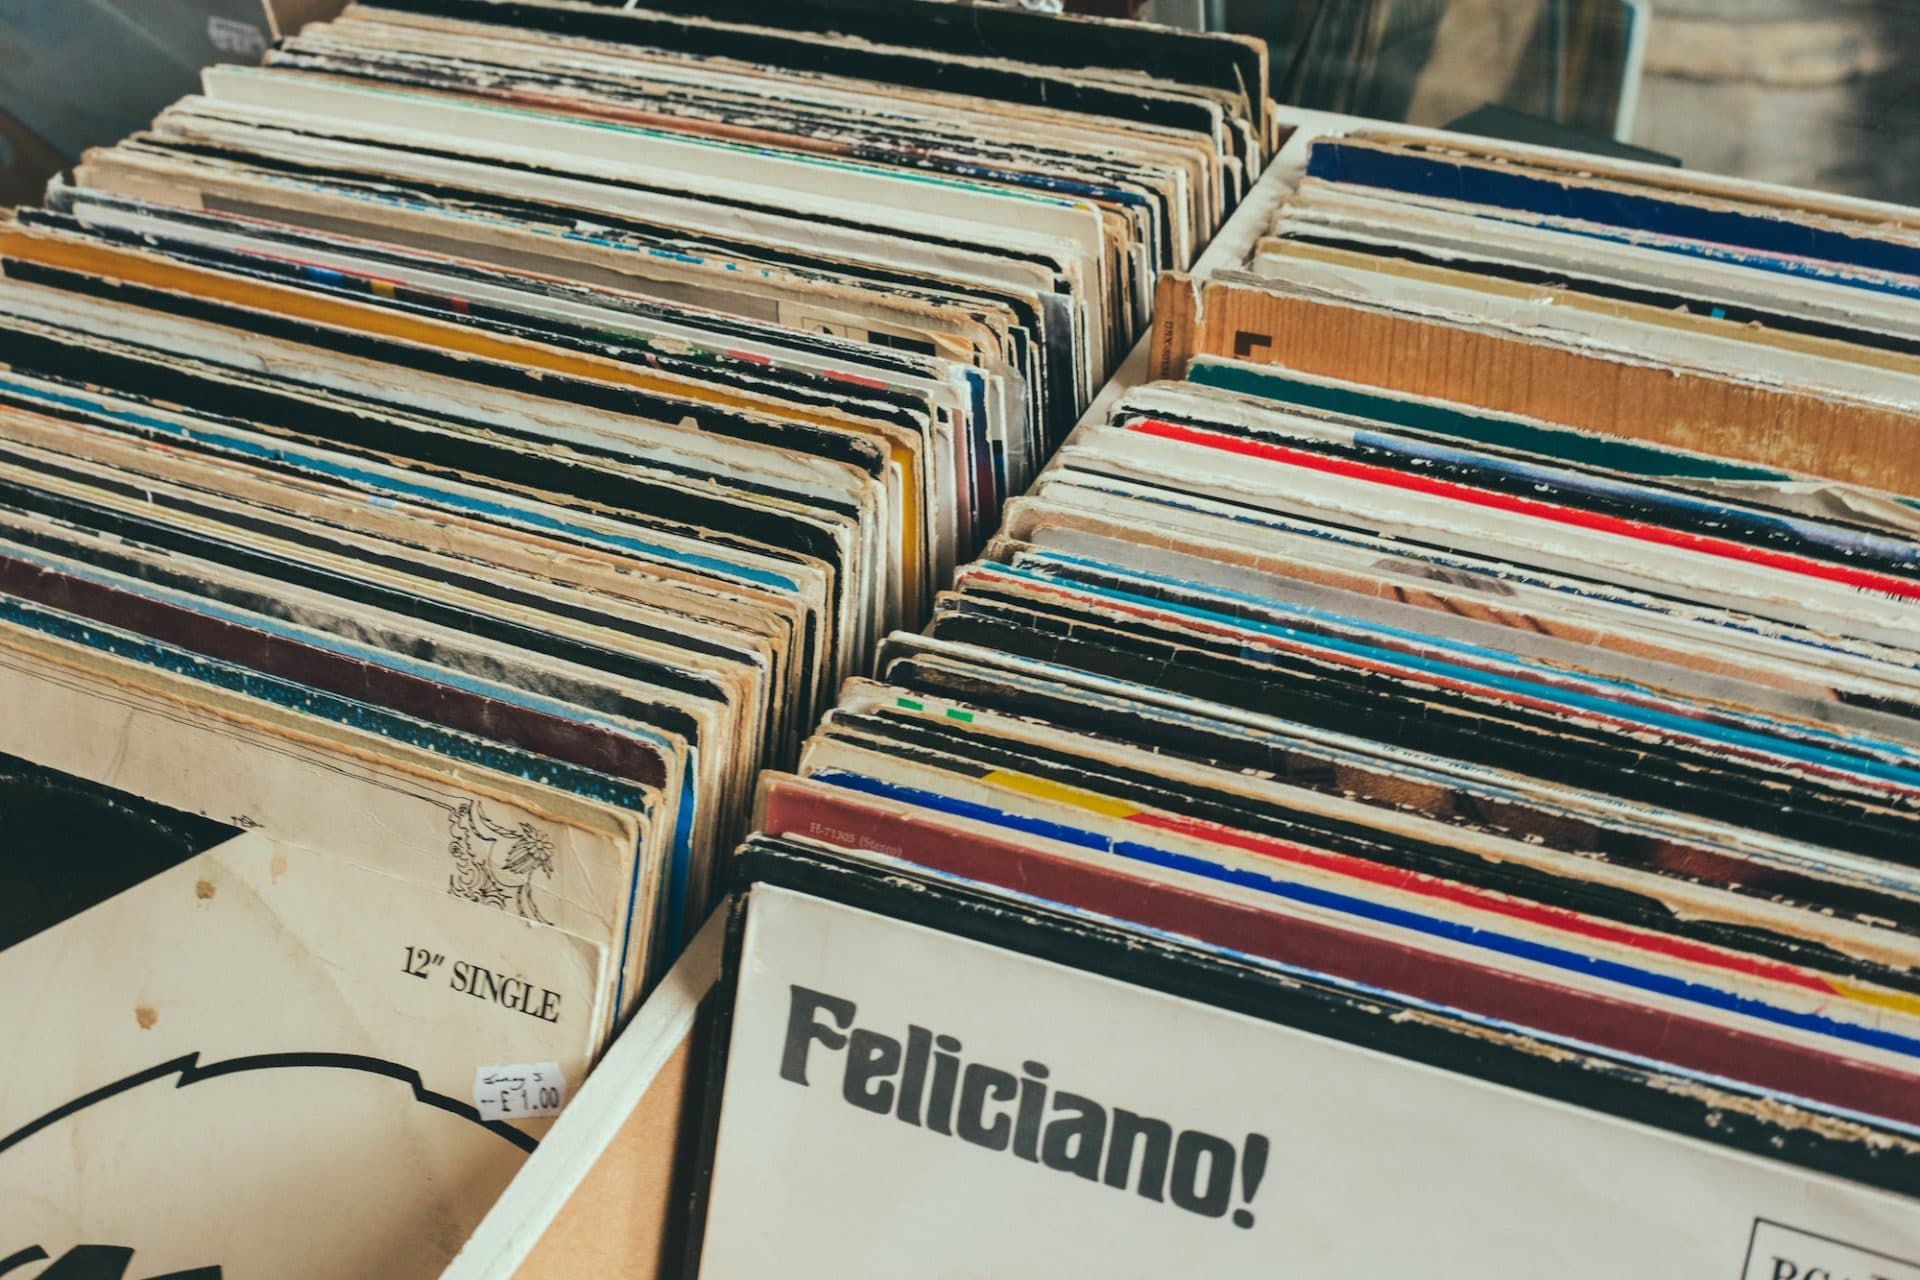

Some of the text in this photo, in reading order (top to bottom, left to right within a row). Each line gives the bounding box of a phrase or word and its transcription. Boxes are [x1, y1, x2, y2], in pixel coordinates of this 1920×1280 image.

[401, 946, 561, 1023] 12" SINGLE
[780, 984, 1270, 1229] Feliciano!
